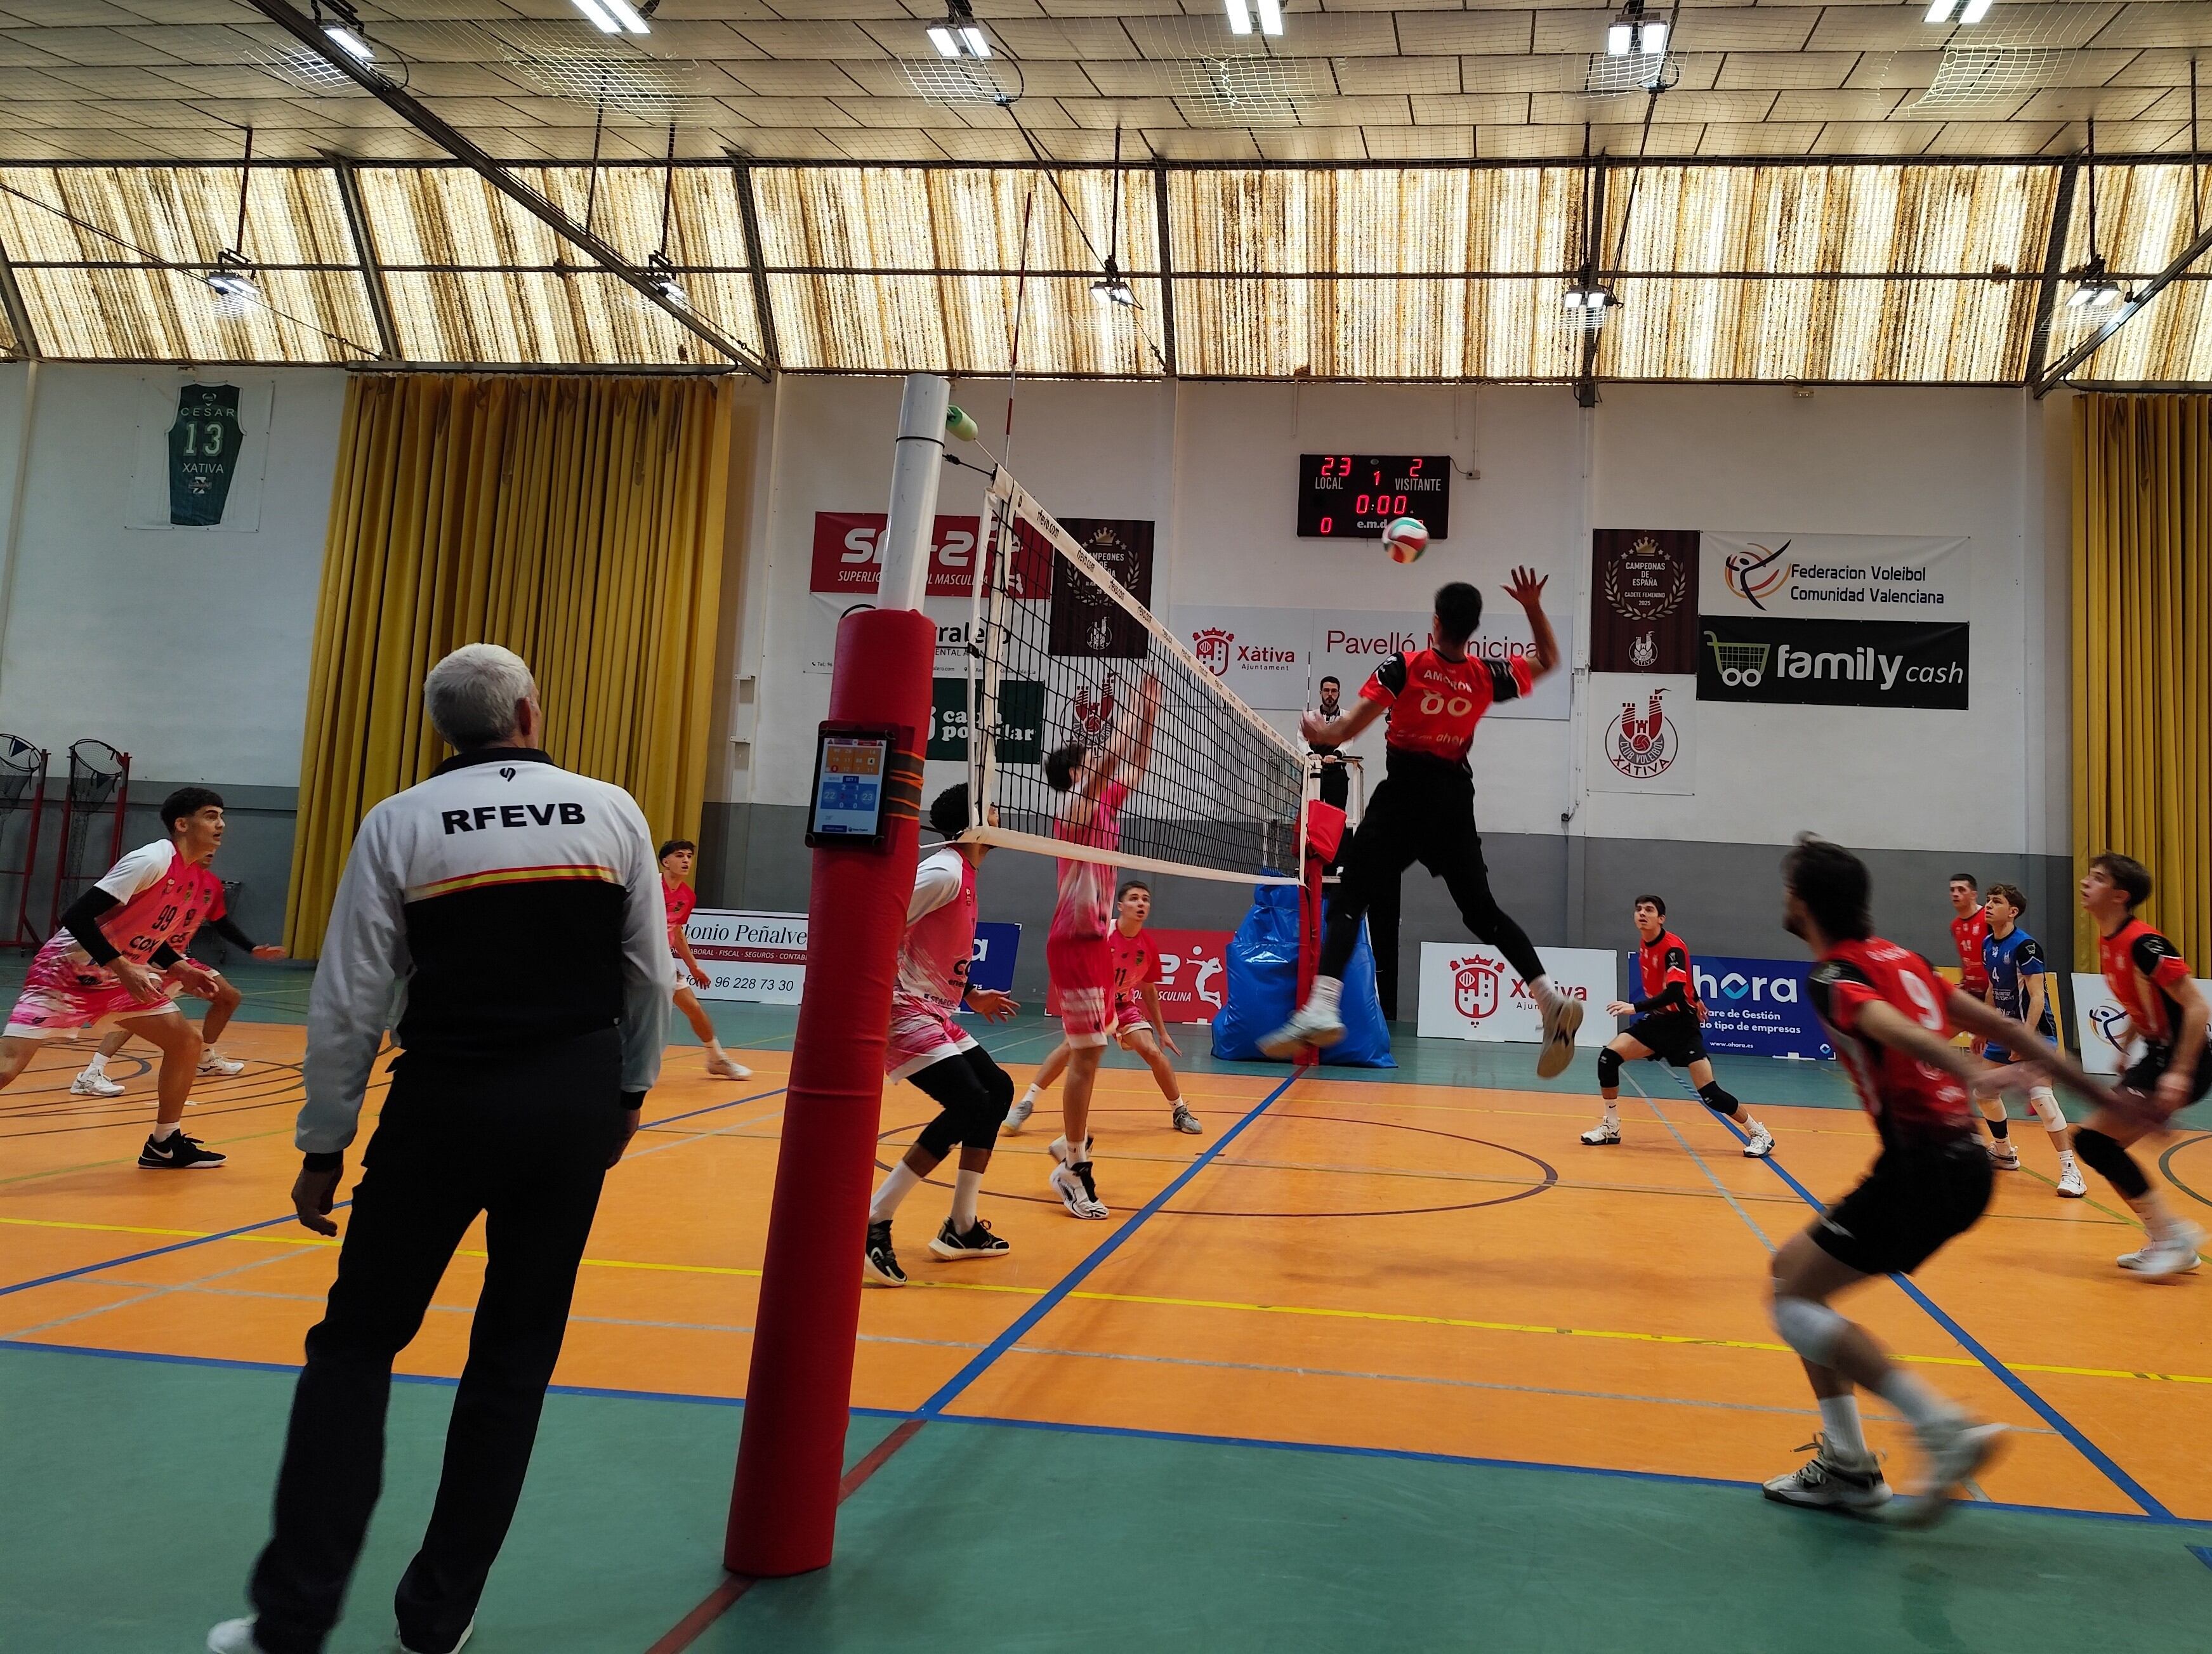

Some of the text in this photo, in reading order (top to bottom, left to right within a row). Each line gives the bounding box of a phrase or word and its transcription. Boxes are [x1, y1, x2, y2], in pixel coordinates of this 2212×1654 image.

[181, 407, 234, 417] CESAR
[183, 421, 223, 456] 13
[182, 463, 223, 473] XATIVA
[1321, 457, 1351, 476] 23
[1410, 459, 1423, 476] 2
[1315, 476, 1343, 489] LOCAL
[1374, 471, 1380, 485] 1
[1395, 478, 1442, 491] VISITANTE
[1320, 517, 1332, 533] 0
[1791, 564, 1926, 581] Federacion Voleibol
[1632, 577, 1657, 586] ESPAÑA
[1791, 586, 1944, 603] Comunidad Valenciana
[1327, 630, 1416, 654] Pavelló
[1237, 646, 1294, 662] Xàtiva
[1777, 645, 1963, 690] family cash
[1620, 740, 1662, 764] CLUB VOLEIBOL
[1613, 754, 1669, 775] XATIVA
[442, 803, 585, 835] RFEVB
[152, 905, 178, 931] 99
[681, 924, 807, 945] tonio Peñalve
[744, 951, 774, 959] SEGUROS
[1115, 968, 1127, 987] 11
[1992, 966, 2000, 982] 4
[715, 977, 730, 987] 96
[733, 978, 756, 988] 228
[761, 979, 774, 990] 73
[779, 980, 793, 991] 30
[1692, 965, 1797, 1003] hora
[1158, 991, 1191, 1002] SCULINA
[1897, 968, 1943, 1031] 9
[1727, 1009, 1740, 1018] de
[1742, 1009, 1781, 1020] Gestión
[1715, 1021, 1734, 1031] tipo
[1737, 1021, 1749, 1030] de
[1752, 1025, 1801, 1034] empresas
